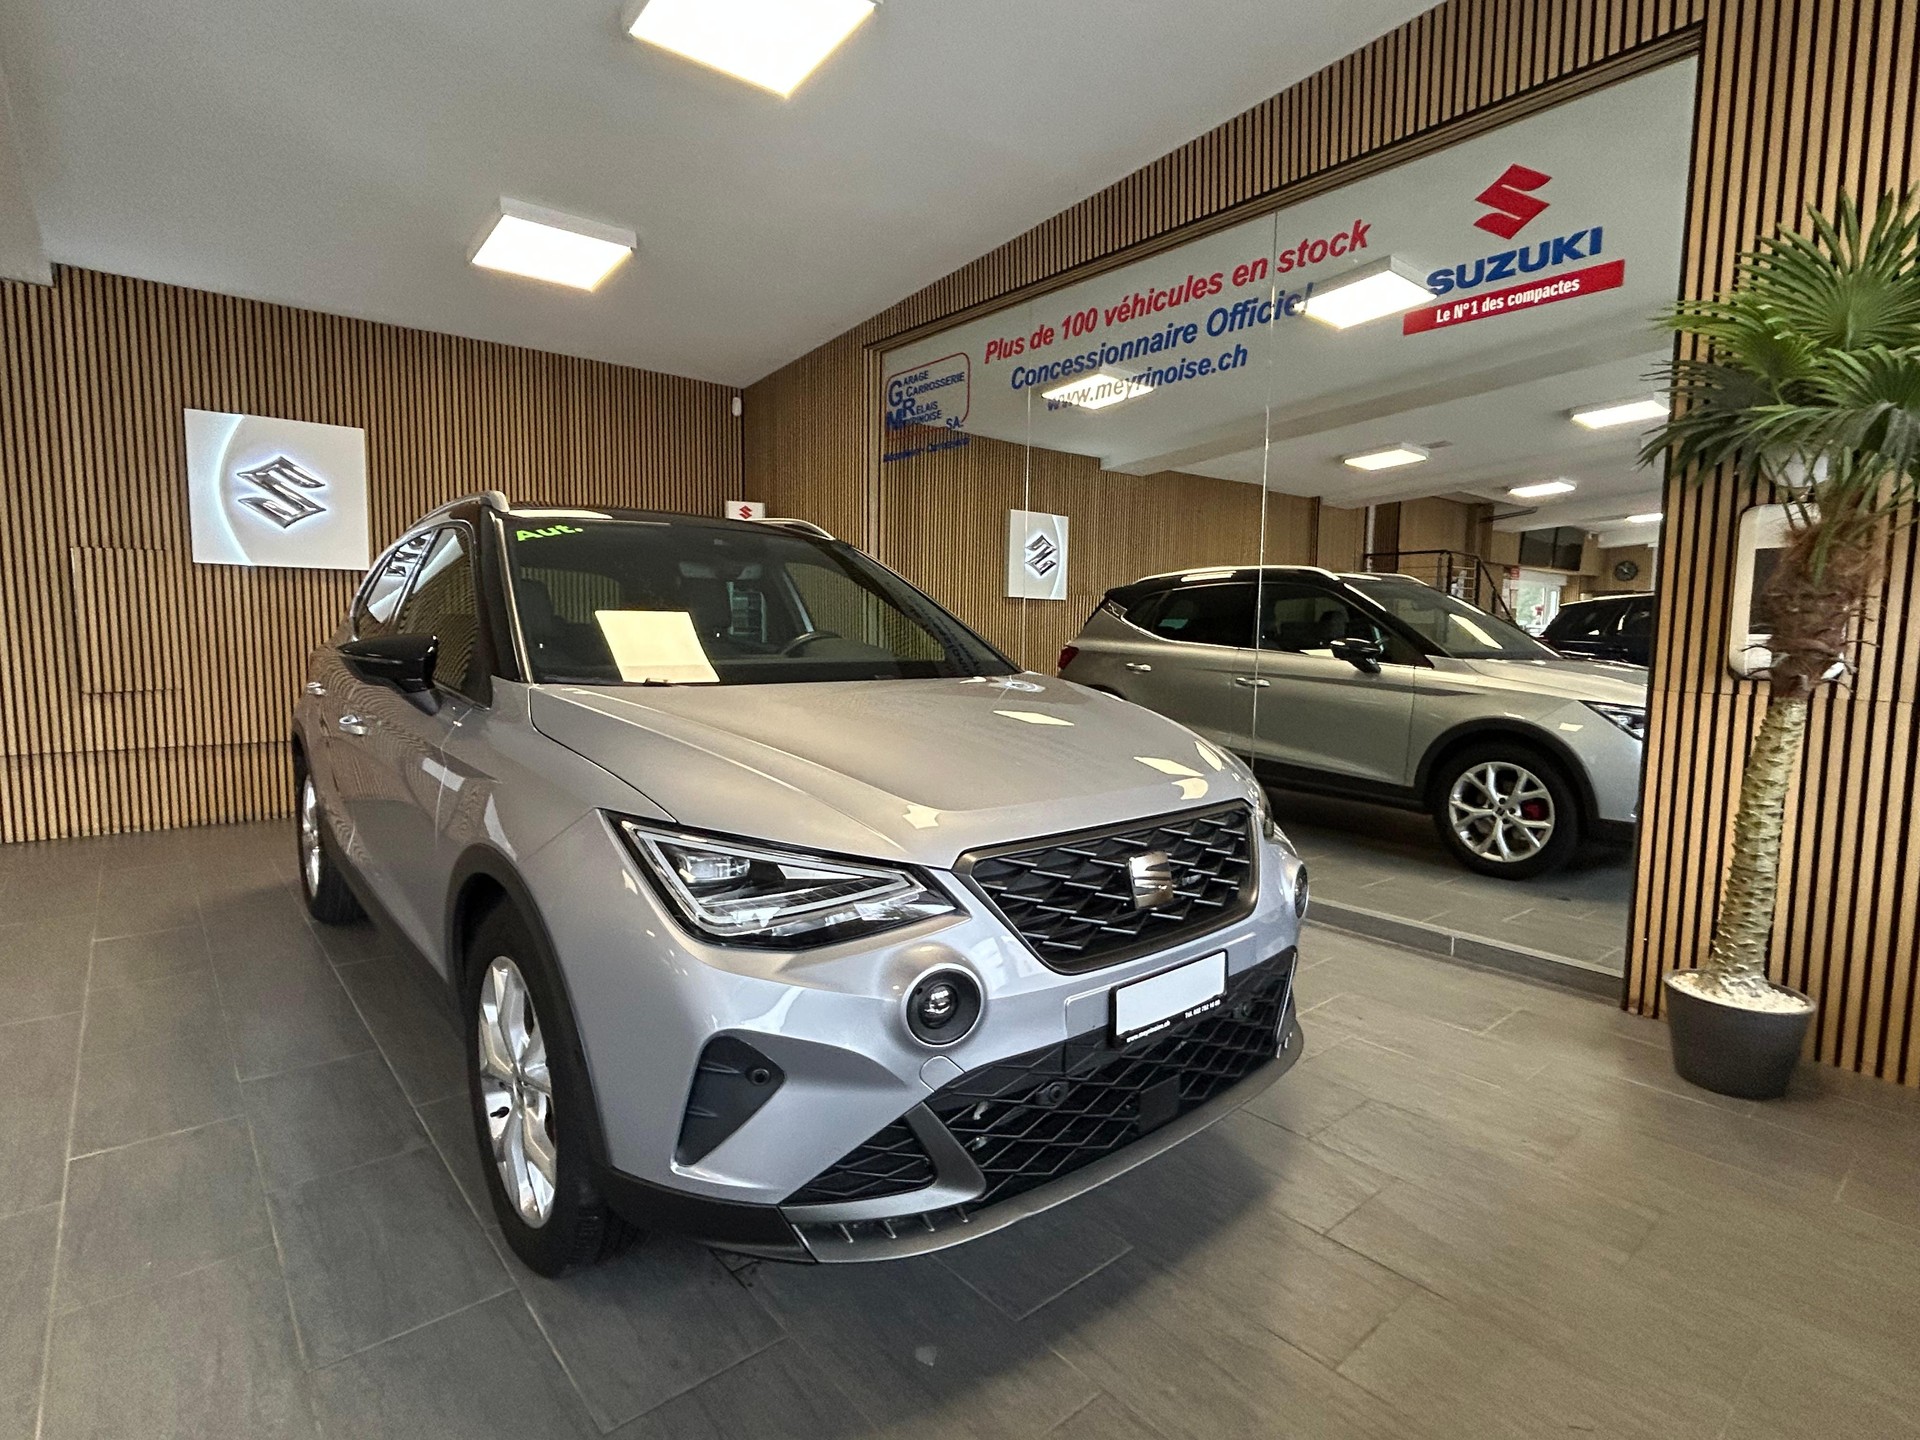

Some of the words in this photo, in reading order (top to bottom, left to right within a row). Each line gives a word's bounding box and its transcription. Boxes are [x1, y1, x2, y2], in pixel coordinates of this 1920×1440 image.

[1426, 226, 1603, 296] SUZUKI
[984, 337, 1025, 364] Plus
[1029, 324, 1055, 350] de
[1061, 307, 1098, 340] 100
[1103, 272, 1224, 327] véhicules
[1231, 257, 1268, 287] en
[1277, 219, 1372, 273] stock
[1436, 309, 1451, 324] Le
[1481, 296, 1504, 313] des
[1507, 278, 1580, 307] compactes
[1011, 322, 1198, 390] Concessionnaire
[1206, 281, 1314, 337] Officiel
[888, 370, 930, 407] GARAGE
[905, 371, 965, 398] CARROSSERIE
[1047, 343, 1248, 411] www.meyrinoise.ch
[902, 397, 939, 418] RELAIS
[516, 524, 584, 542] Aut.
